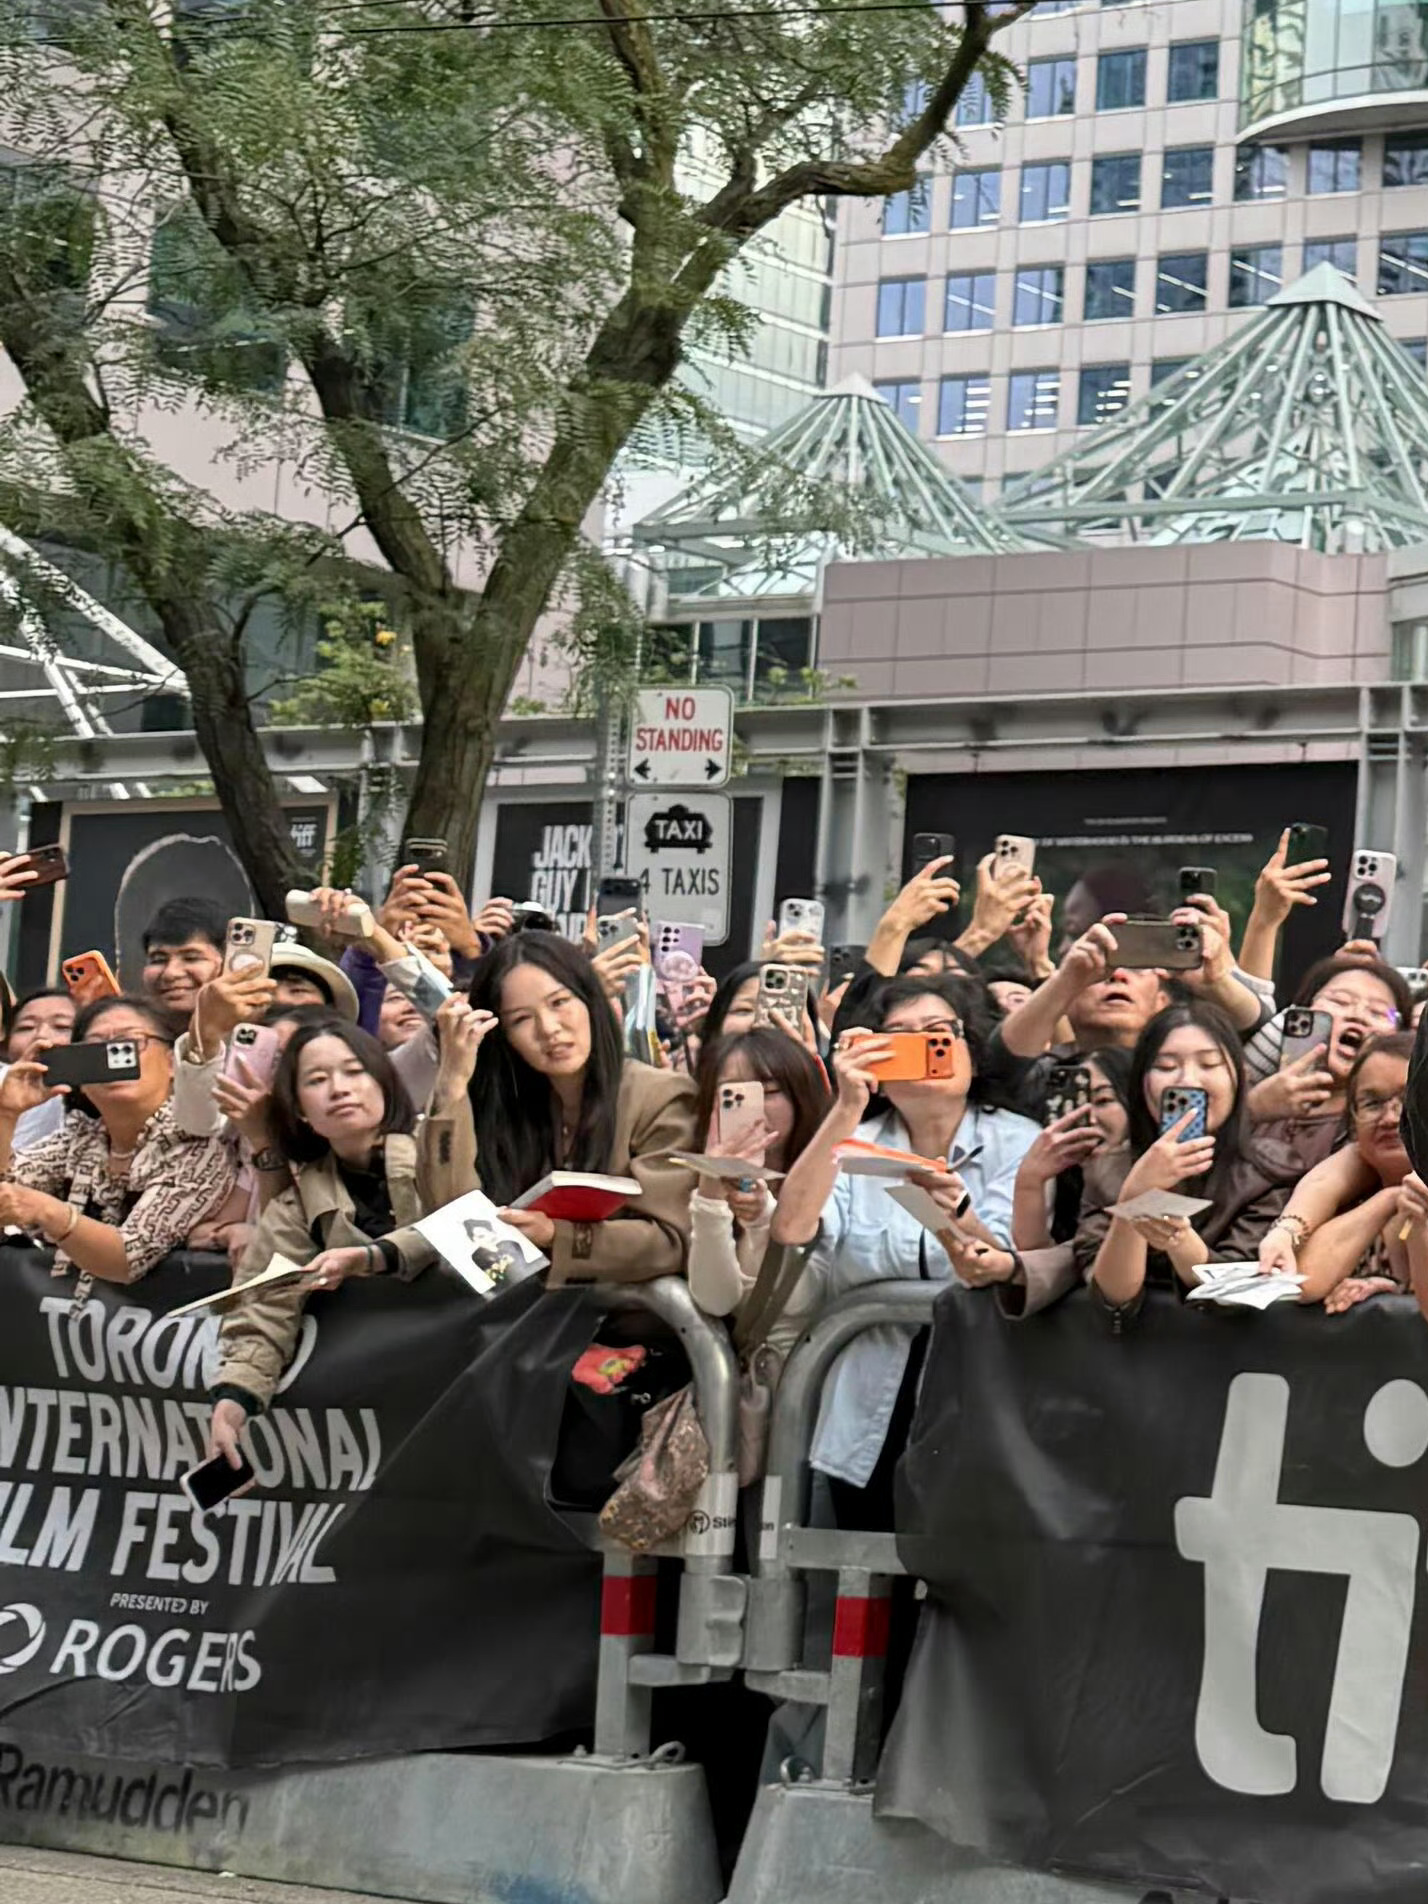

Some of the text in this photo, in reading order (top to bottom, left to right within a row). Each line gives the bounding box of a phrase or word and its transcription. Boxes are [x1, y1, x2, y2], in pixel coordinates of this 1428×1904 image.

[665, 697, 695, 721] NO
[635, 728, 723, 752] STANDING
[655, 820, 703, 840] TAXI
[662, 868, 720, 895] TAXIS
[0, 1385, 381, 1491] NTERNATONAL
[110, 1592, 209, 1615] PRESENTED BY
[49, 1618, 262, 1693] ROGERS
[0, 1743, 250, 1835] Ramudden
